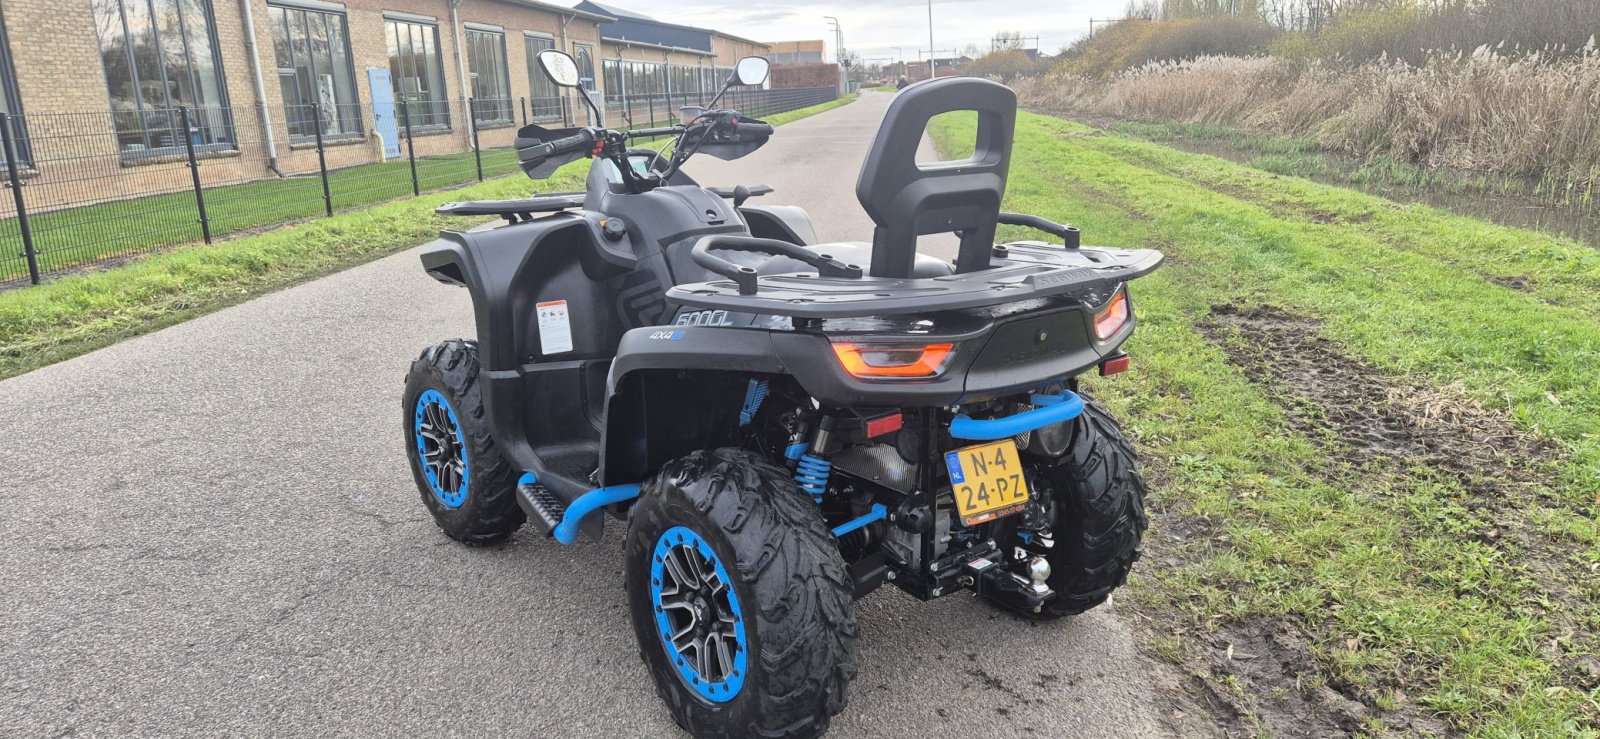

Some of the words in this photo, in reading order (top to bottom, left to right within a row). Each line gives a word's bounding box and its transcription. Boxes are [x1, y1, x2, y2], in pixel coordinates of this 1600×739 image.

[676, 309, 733, 326] 600GL
[971, 447, 1007, 477] N-4
[952, 471, 962, 480] NL
[961, 474, 1024, 511] 24-PZ
